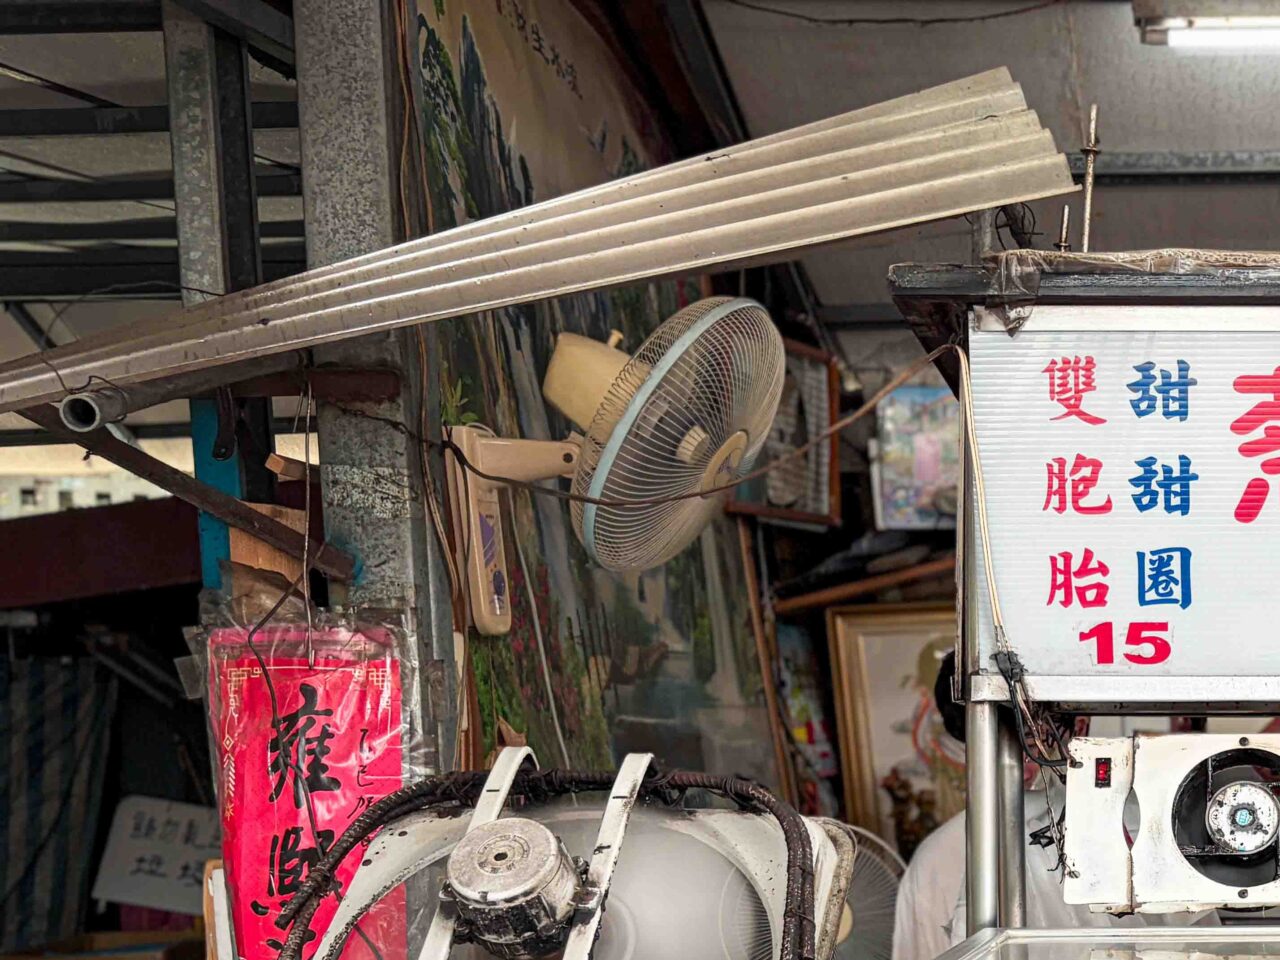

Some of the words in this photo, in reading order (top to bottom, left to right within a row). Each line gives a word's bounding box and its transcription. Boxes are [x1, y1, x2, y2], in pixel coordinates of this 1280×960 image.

[1042, 355, 1113, 609] 雙胞胎
[1125, 357, 1199, 610] 甜甜圈
[1079, 621, 1172, 665] 15
